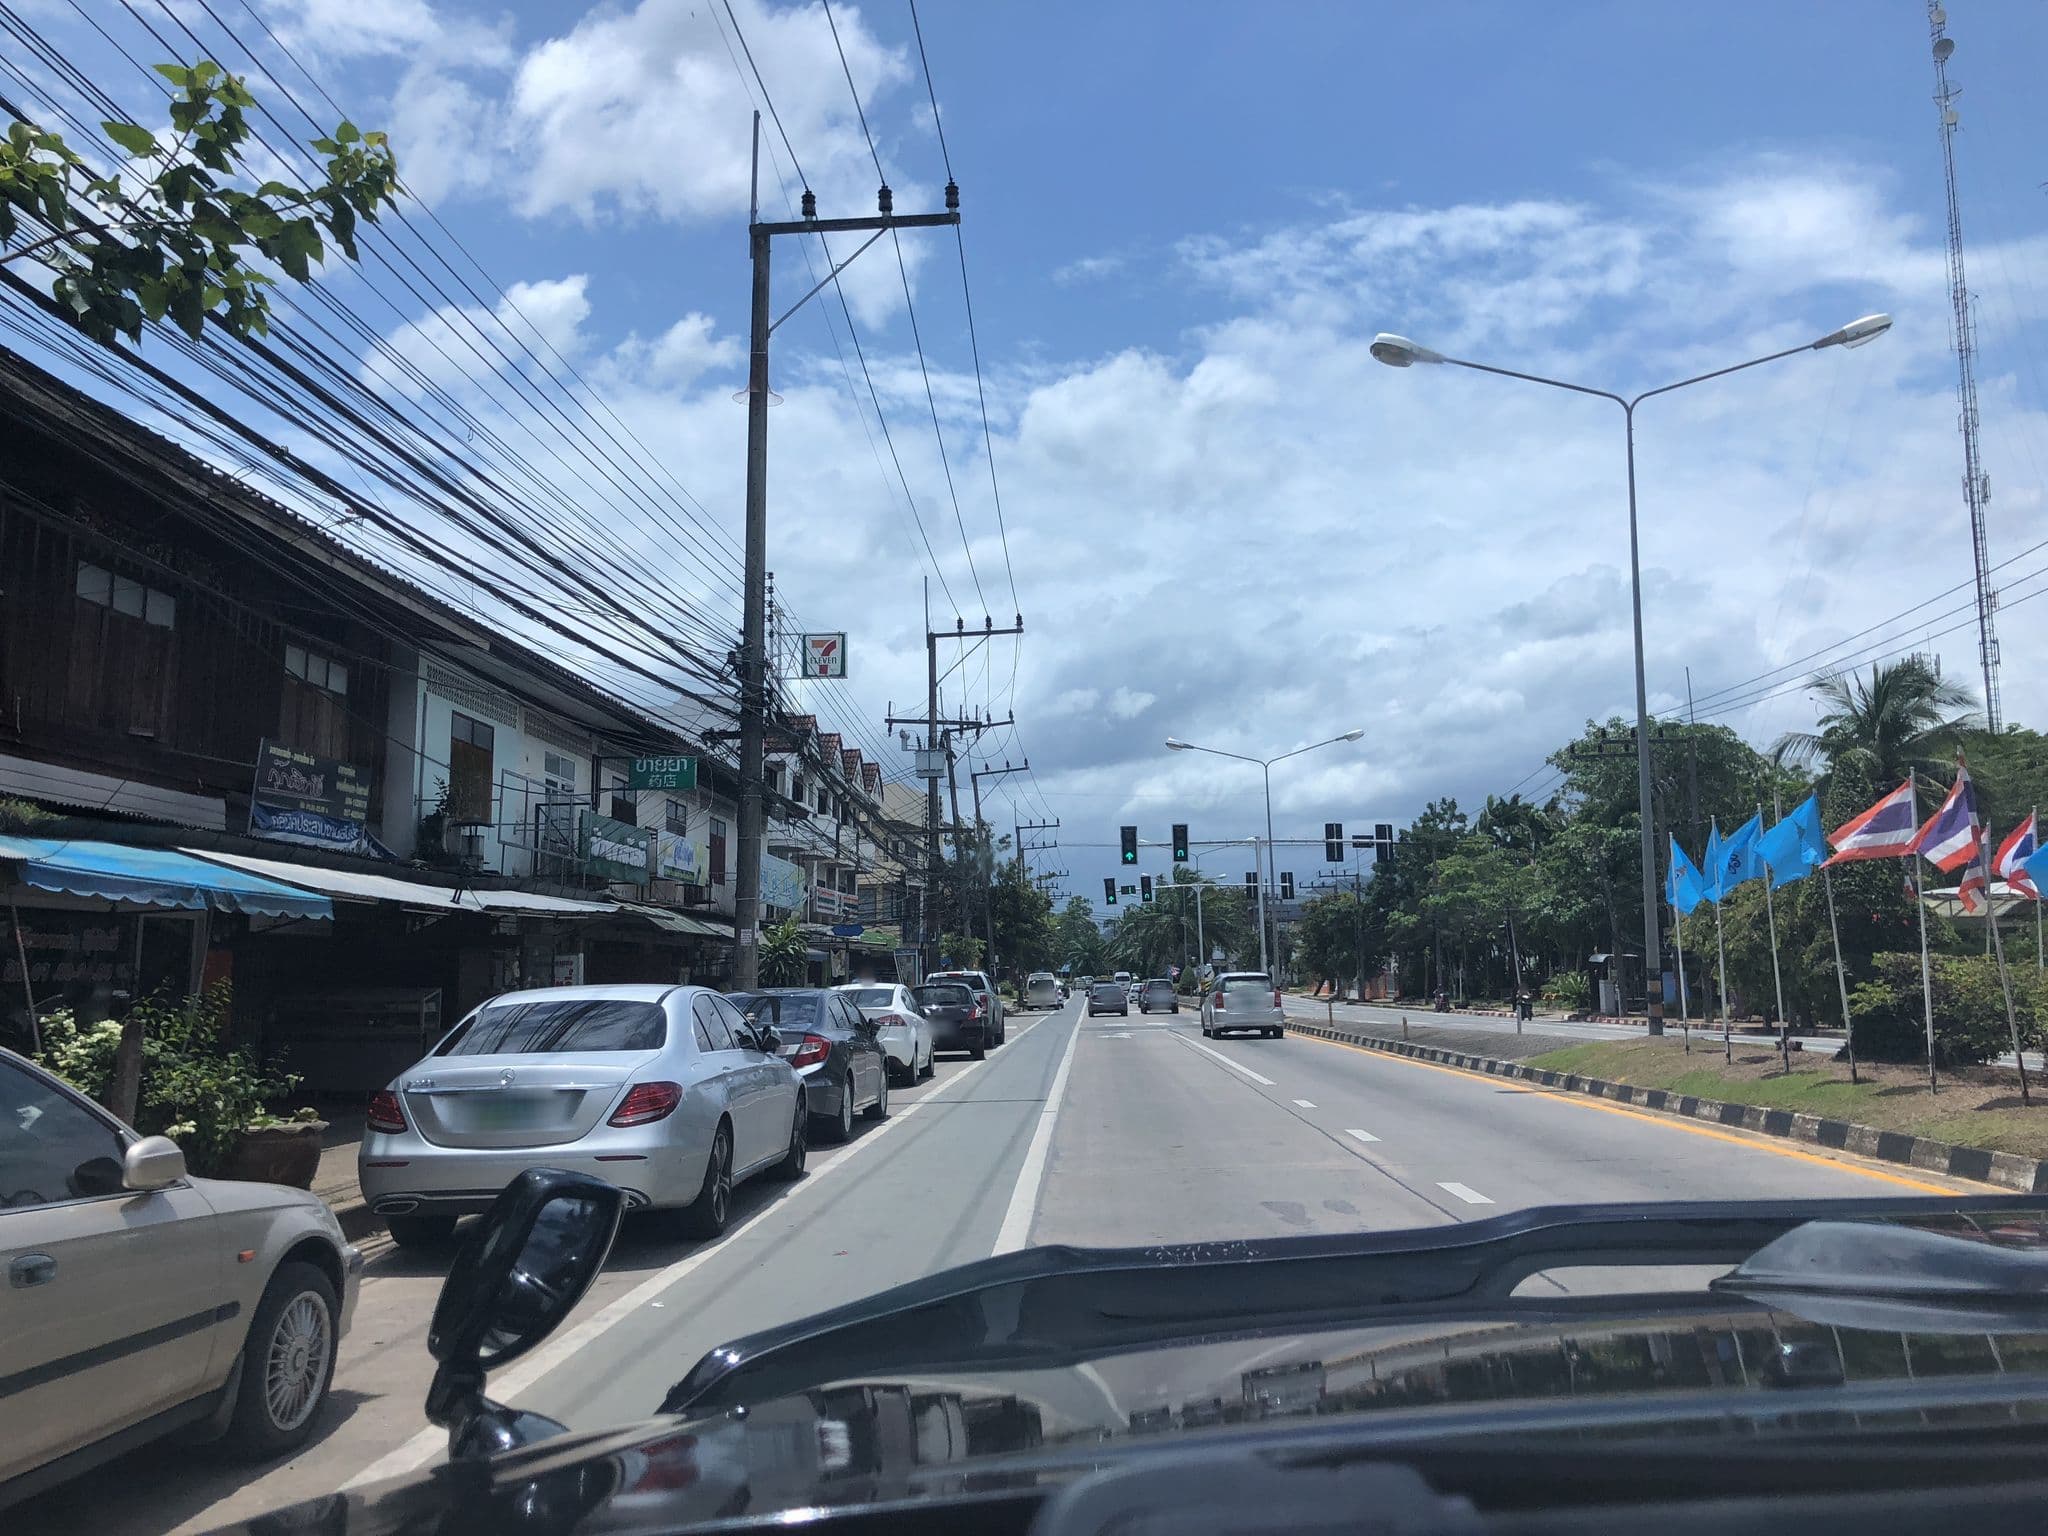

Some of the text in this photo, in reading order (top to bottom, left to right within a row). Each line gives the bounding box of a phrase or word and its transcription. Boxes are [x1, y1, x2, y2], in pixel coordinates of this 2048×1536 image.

[812, 640, 837, 675] 7
[636, 758, 688, 772] ขายยา
[648, 774, 677, 788] 药店
